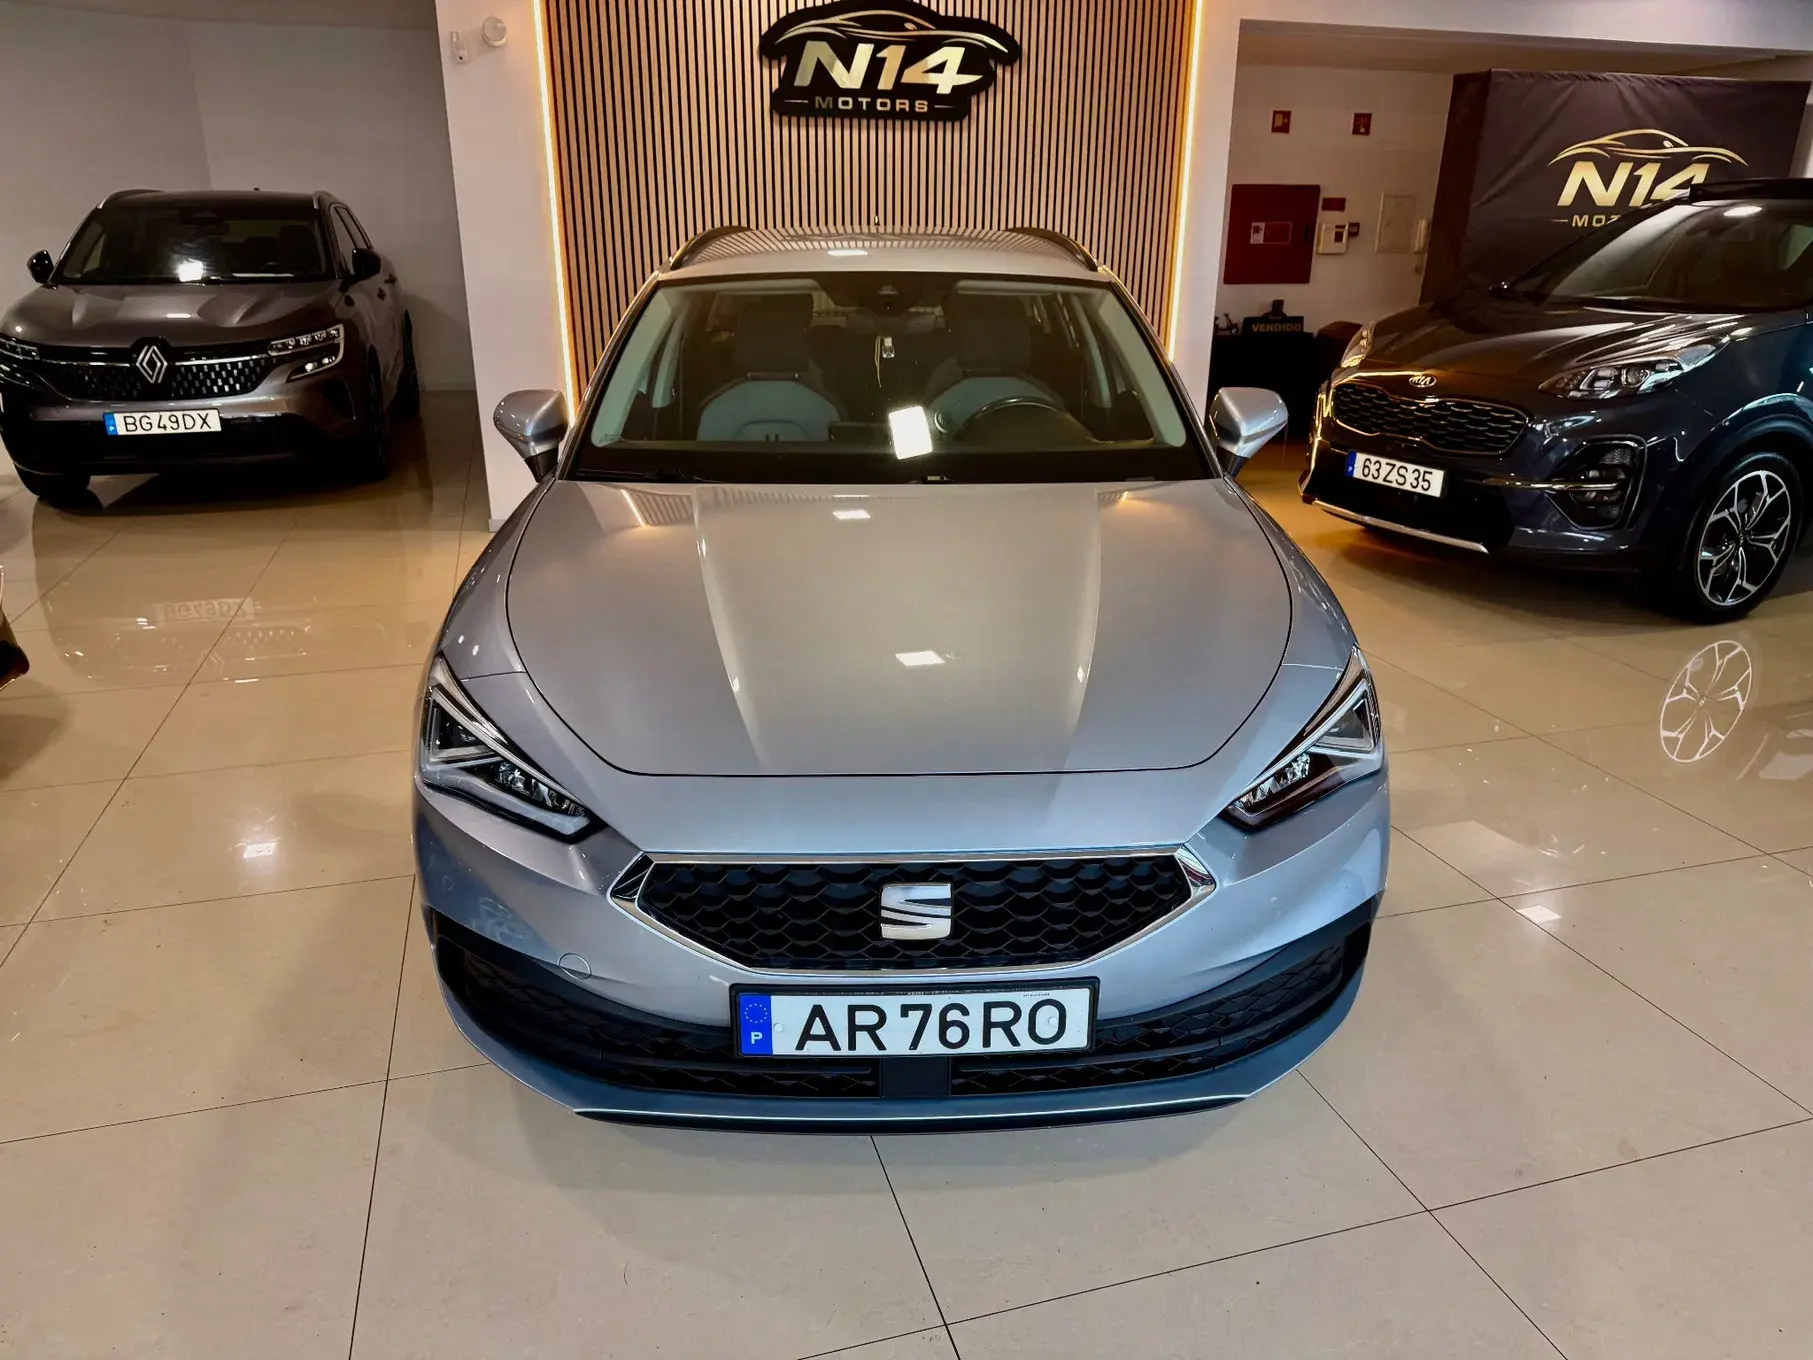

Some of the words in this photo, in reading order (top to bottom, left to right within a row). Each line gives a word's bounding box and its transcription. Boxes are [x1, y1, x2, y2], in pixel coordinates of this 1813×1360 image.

[793, 40, 984, 94] N14
[814, 96, 929, 112] MOTORS
[1557, 161, 1710, 207] N14
[1251, 322, 1302, 332] VENDIDO
[123, 412, 212, 432] BG49DX
[1361, 458, 1433, 491] 63ZS35
[750, 1031, 763, 1045] P
